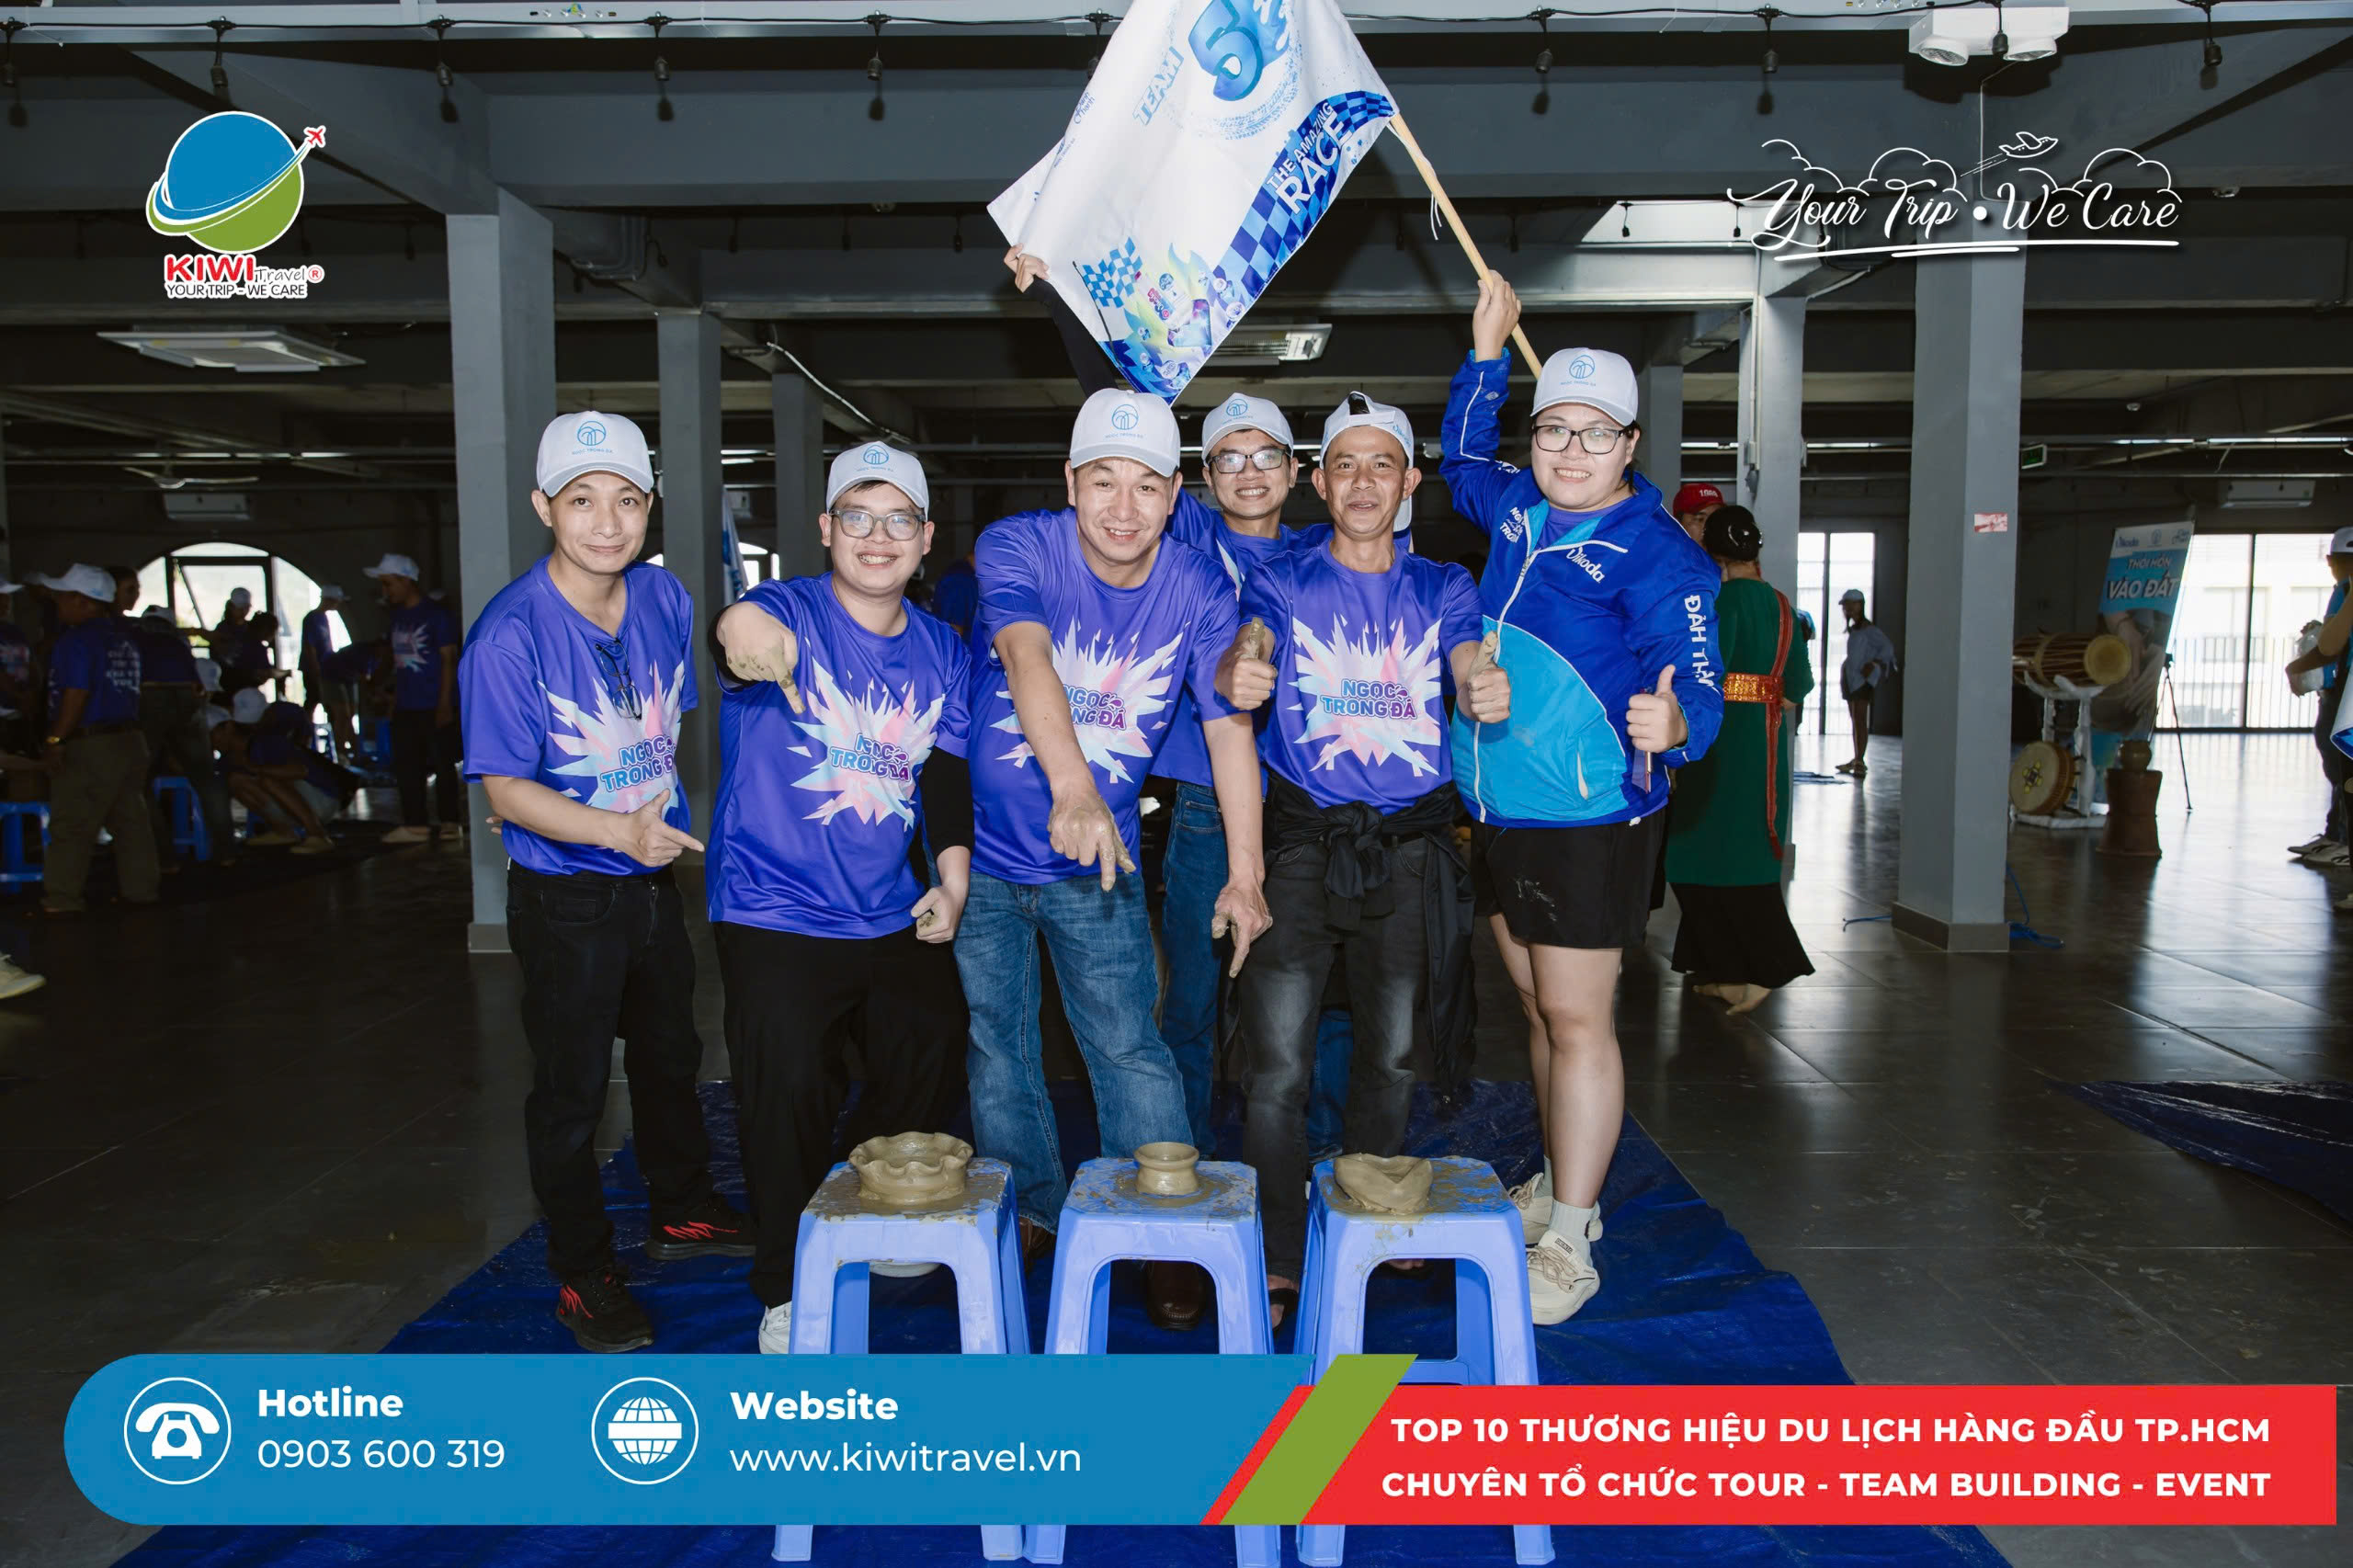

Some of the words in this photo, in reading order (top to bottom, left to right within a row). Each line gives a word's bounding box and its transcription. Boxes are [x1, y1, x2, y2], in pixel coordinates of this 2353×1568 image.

[1131, 46, 1185, 127] TEAM
[1267, 158, 1297, 189] THE
[1293, 102, 1335, 164] AMAZING
[1275, 110, 1353, 216] RACE
[1565, 545, 1606, 584] Vikoda
[2107, 575, 2142, 600] VÀO
[2143, 569, 2179, 598] ĐẤT
[1341, 678, 1397, 699] NGỌC
[1098, 709, 1127, 731] ĐÁ
[1321, 695, 1390, 717] TRONG
[1390, 699, 1417, 720] ĐÁ
[600, 757, 663, 792] TRONG
[663, 752, 676, 773] Đ
[830, 746, 889, 778] TROG
